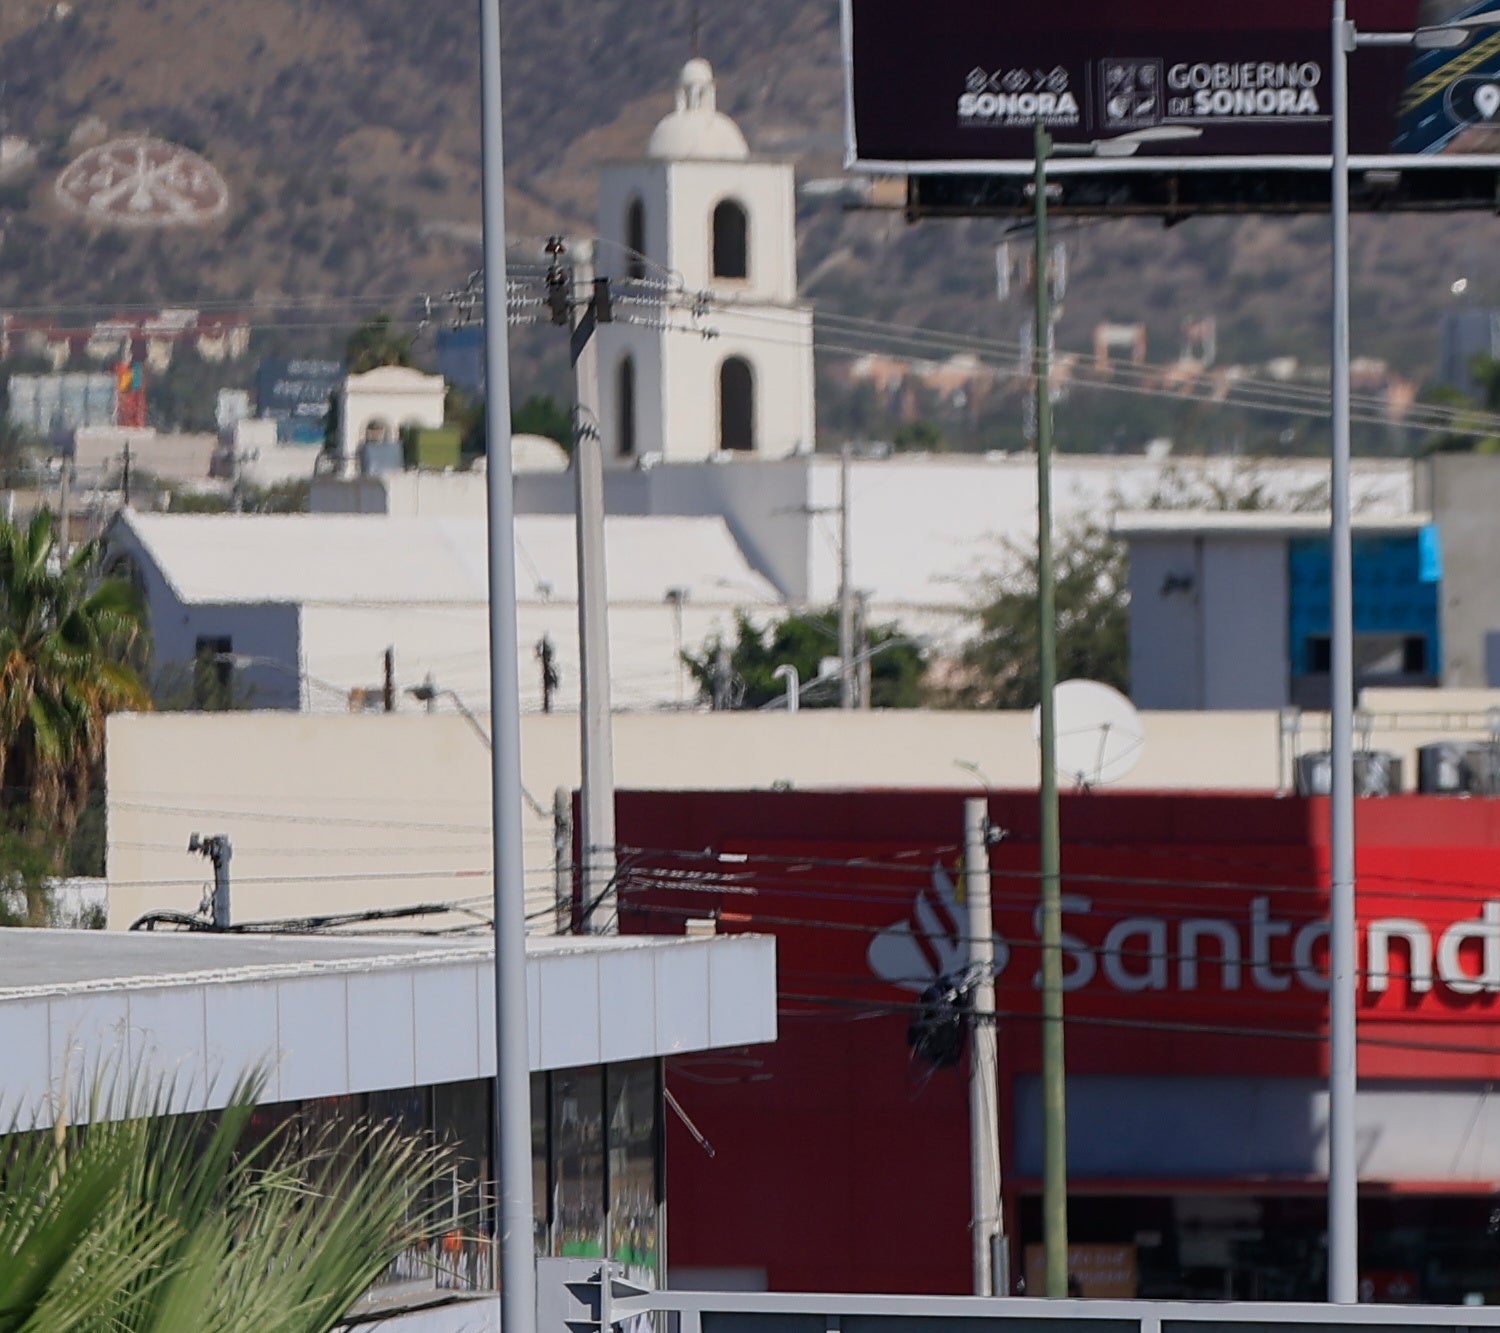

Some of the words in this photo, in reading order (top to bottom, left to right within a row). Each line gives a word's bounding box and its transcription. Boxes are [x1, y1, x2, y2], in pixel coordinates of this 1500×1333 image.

[1168, 62, 1321, 89] GOBIERNO
[958, 93, 1079, 116] SONORA
[1194, 88, 1320, 115] SONORA
